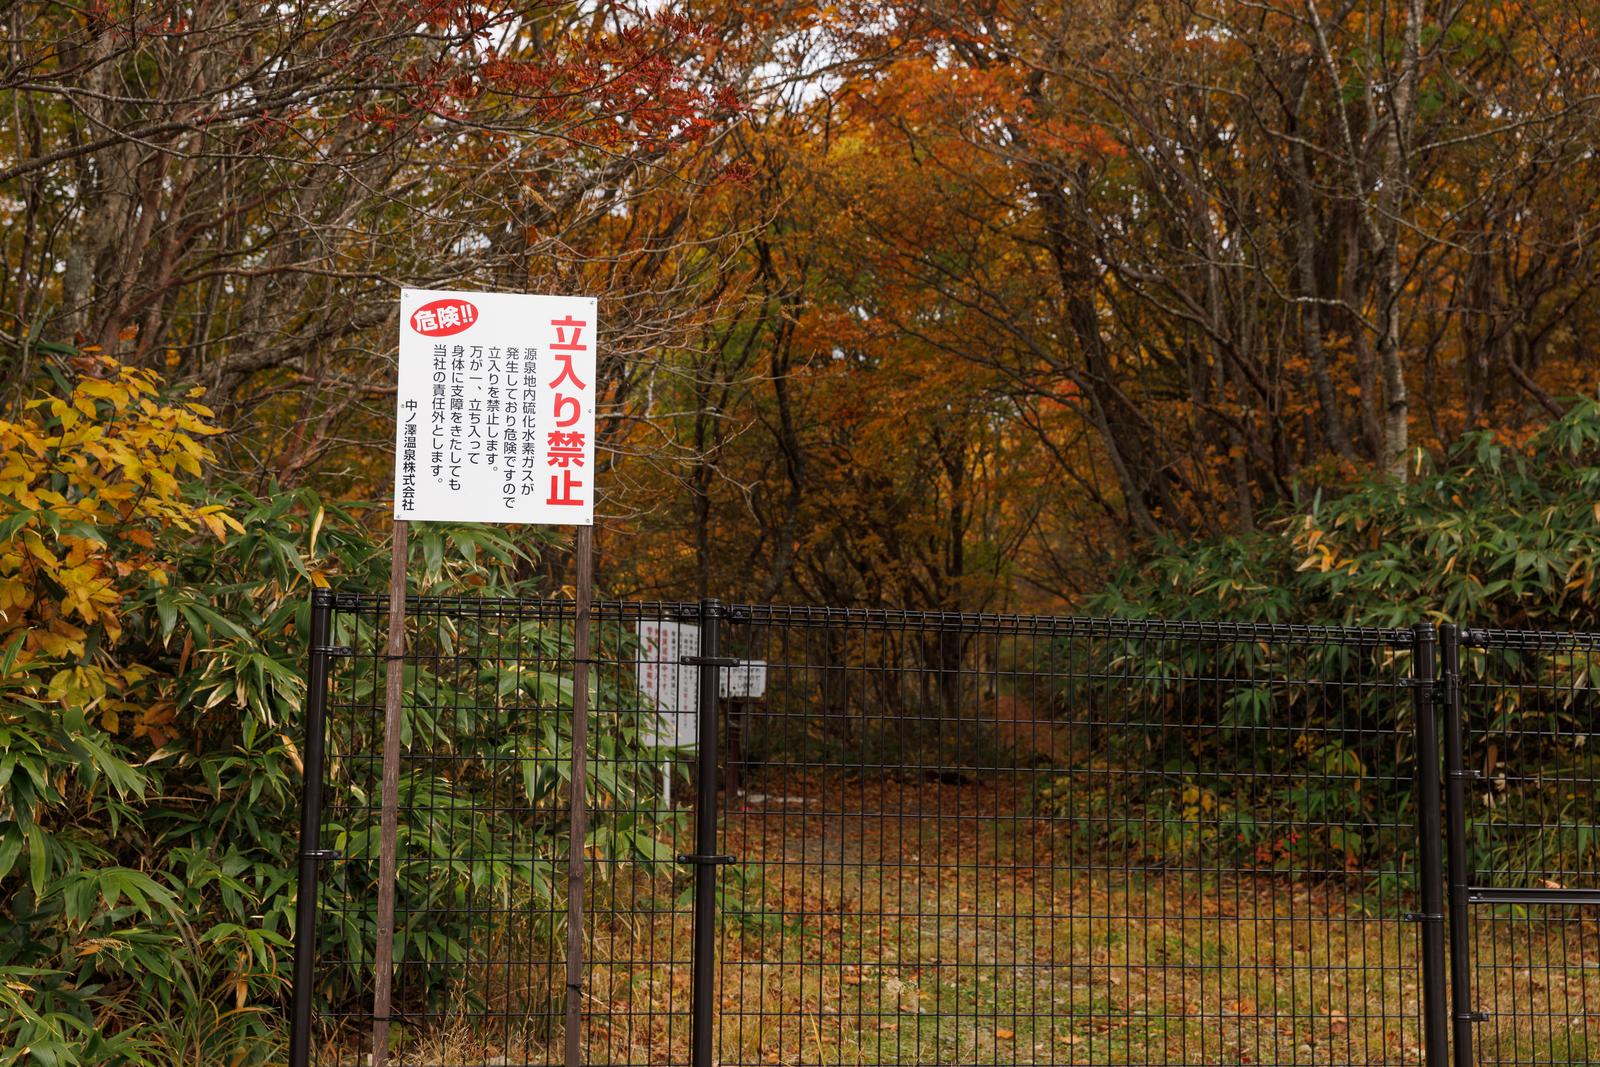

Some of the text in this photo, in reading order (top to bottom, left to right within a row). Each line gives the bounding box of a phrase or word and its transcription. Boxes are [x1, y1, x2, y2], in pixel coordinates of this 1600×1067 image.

[414, 304, 473, 332] 危険!!
[402, 399, 418, 511] 中ノ澤温泉株式会社
[430, 344, 447, 483] 当社の責任外とします。
[448, 345, 465, 491] 身体に支障をきたしても
[467, 345, 483, 464] 万が一、立ち入って
[485, 346, 501, 471] 立入りを禁止します。
[502, 347, 519, 509] 発生しており危険ですので
[521, 348, 537, 496] 源泉地内硫化水素ガスが
[546, 315, 587, 506] 立入り禁止
